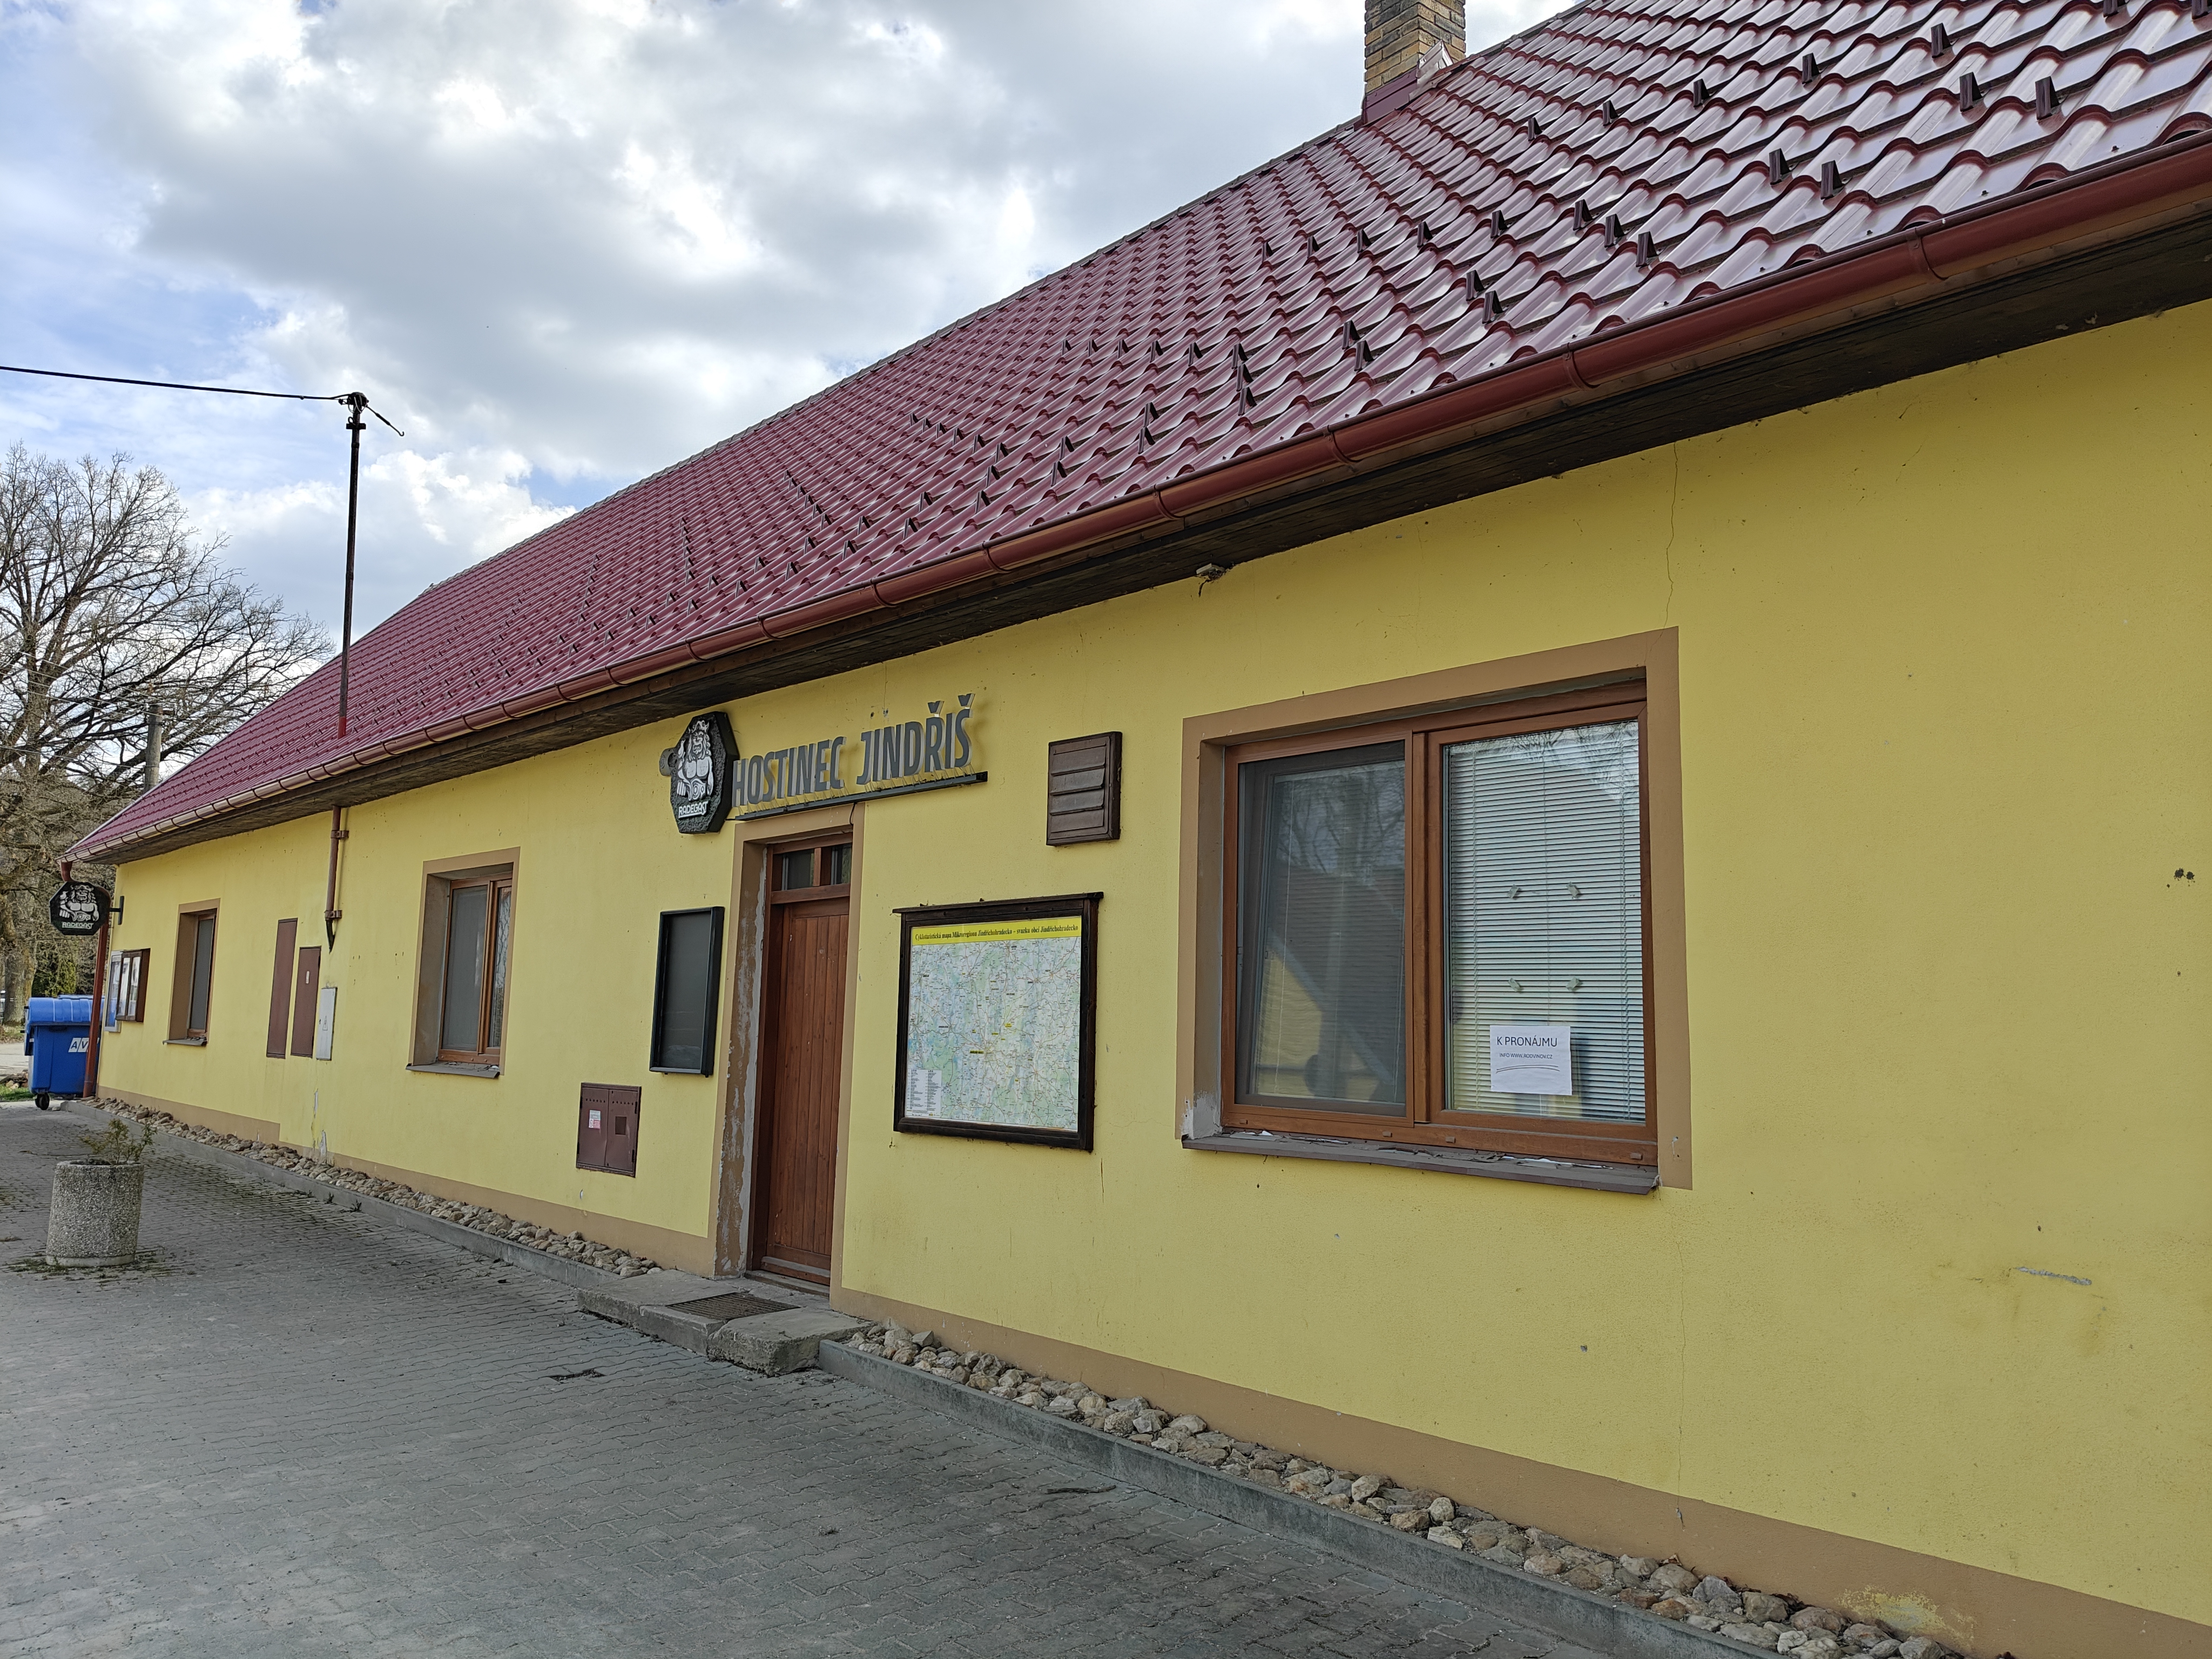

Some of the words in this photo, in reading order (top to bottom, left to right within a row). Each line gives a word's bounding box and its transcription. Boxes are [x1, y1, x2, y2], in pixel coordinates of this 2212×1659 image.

[732, 736, 847, 807] HOSTINEC
[856, 693, 975, 785] JINDŘIŠ
[678, 800, 709, 818] RADEGAST
[62, 921, 94, 929] RADEGAST
[978, 927, 1013, 936] Jindřichohradecko
[1041, 924, 1078, 933] Jindřichohradecko
[1497, 1036, 1503, 1046] K
[1505, 1035, 1557, 1047] PRONÁJMU
